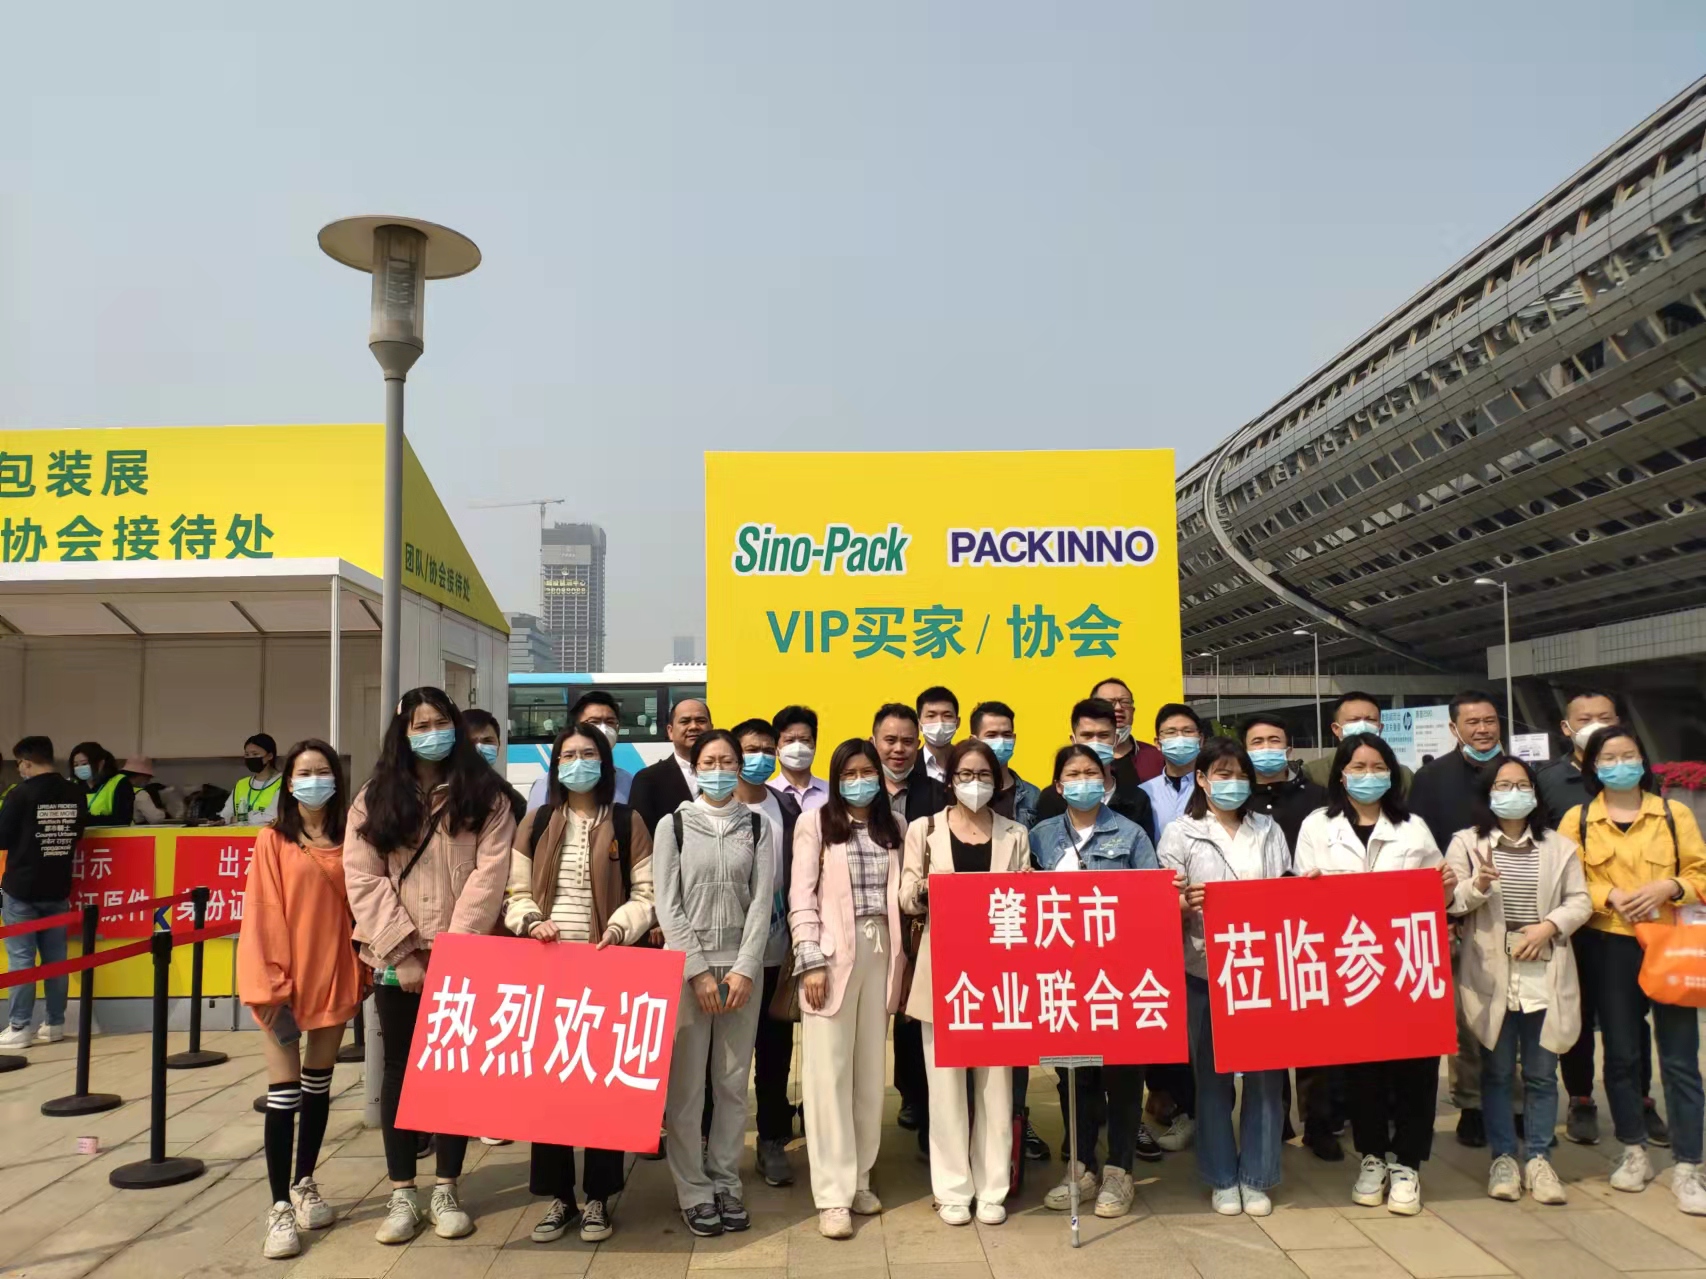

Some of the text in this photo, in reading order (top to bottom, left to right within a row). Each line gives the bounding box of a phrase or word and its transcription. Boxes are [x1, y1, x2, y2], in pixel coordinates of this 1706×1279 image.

[0, 450, 149, 498] 包装展
[0, 513, 275, 563] 协会接待处
[734, 526, 1155, 573] Sino-Pack PACKINNO
[987, 885, 1119, 950] 肇庆市
[1214, 911, 1446, 1016] 莅临参观
[416, 975, 668, 1091] 热烈欢迎
[944, 968, 1170, 1033] 企业联合会
